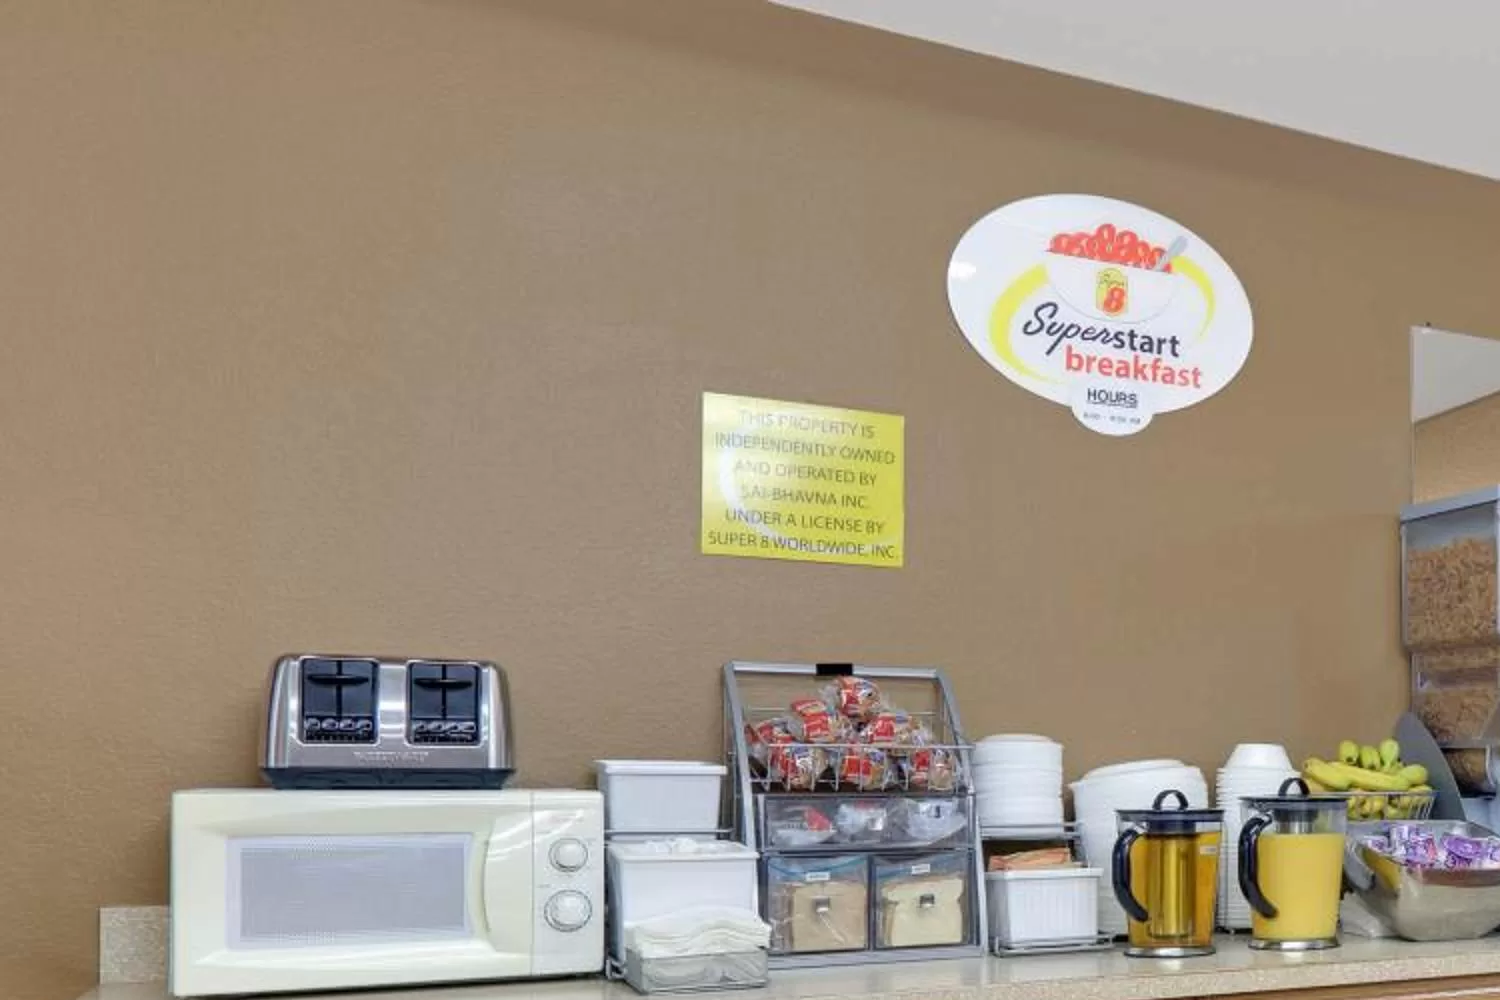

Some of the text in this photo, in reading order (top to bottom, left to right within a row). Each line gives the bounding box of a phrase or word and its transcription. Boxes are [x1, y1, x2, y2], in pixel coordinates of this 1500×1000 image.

[1102, 286, 1126, 313] 8
[1022, 301, 1180, 357] Superstart
[1065, 345, 1202, 388] breakfast
[1087, 387, 1138, 405] HOURS
[777, 414, 857, 436] PROPERTY
[861, 424, 876, 439] IS
[714, 431, 896, 465] INDEPENDENTLY OWNED
[734, 460, 877, 488] AND OPERATED BY
[725, 507, 886, 536] UNDER A LICENSE BY
[708, 531, 757, 547] SUPER
